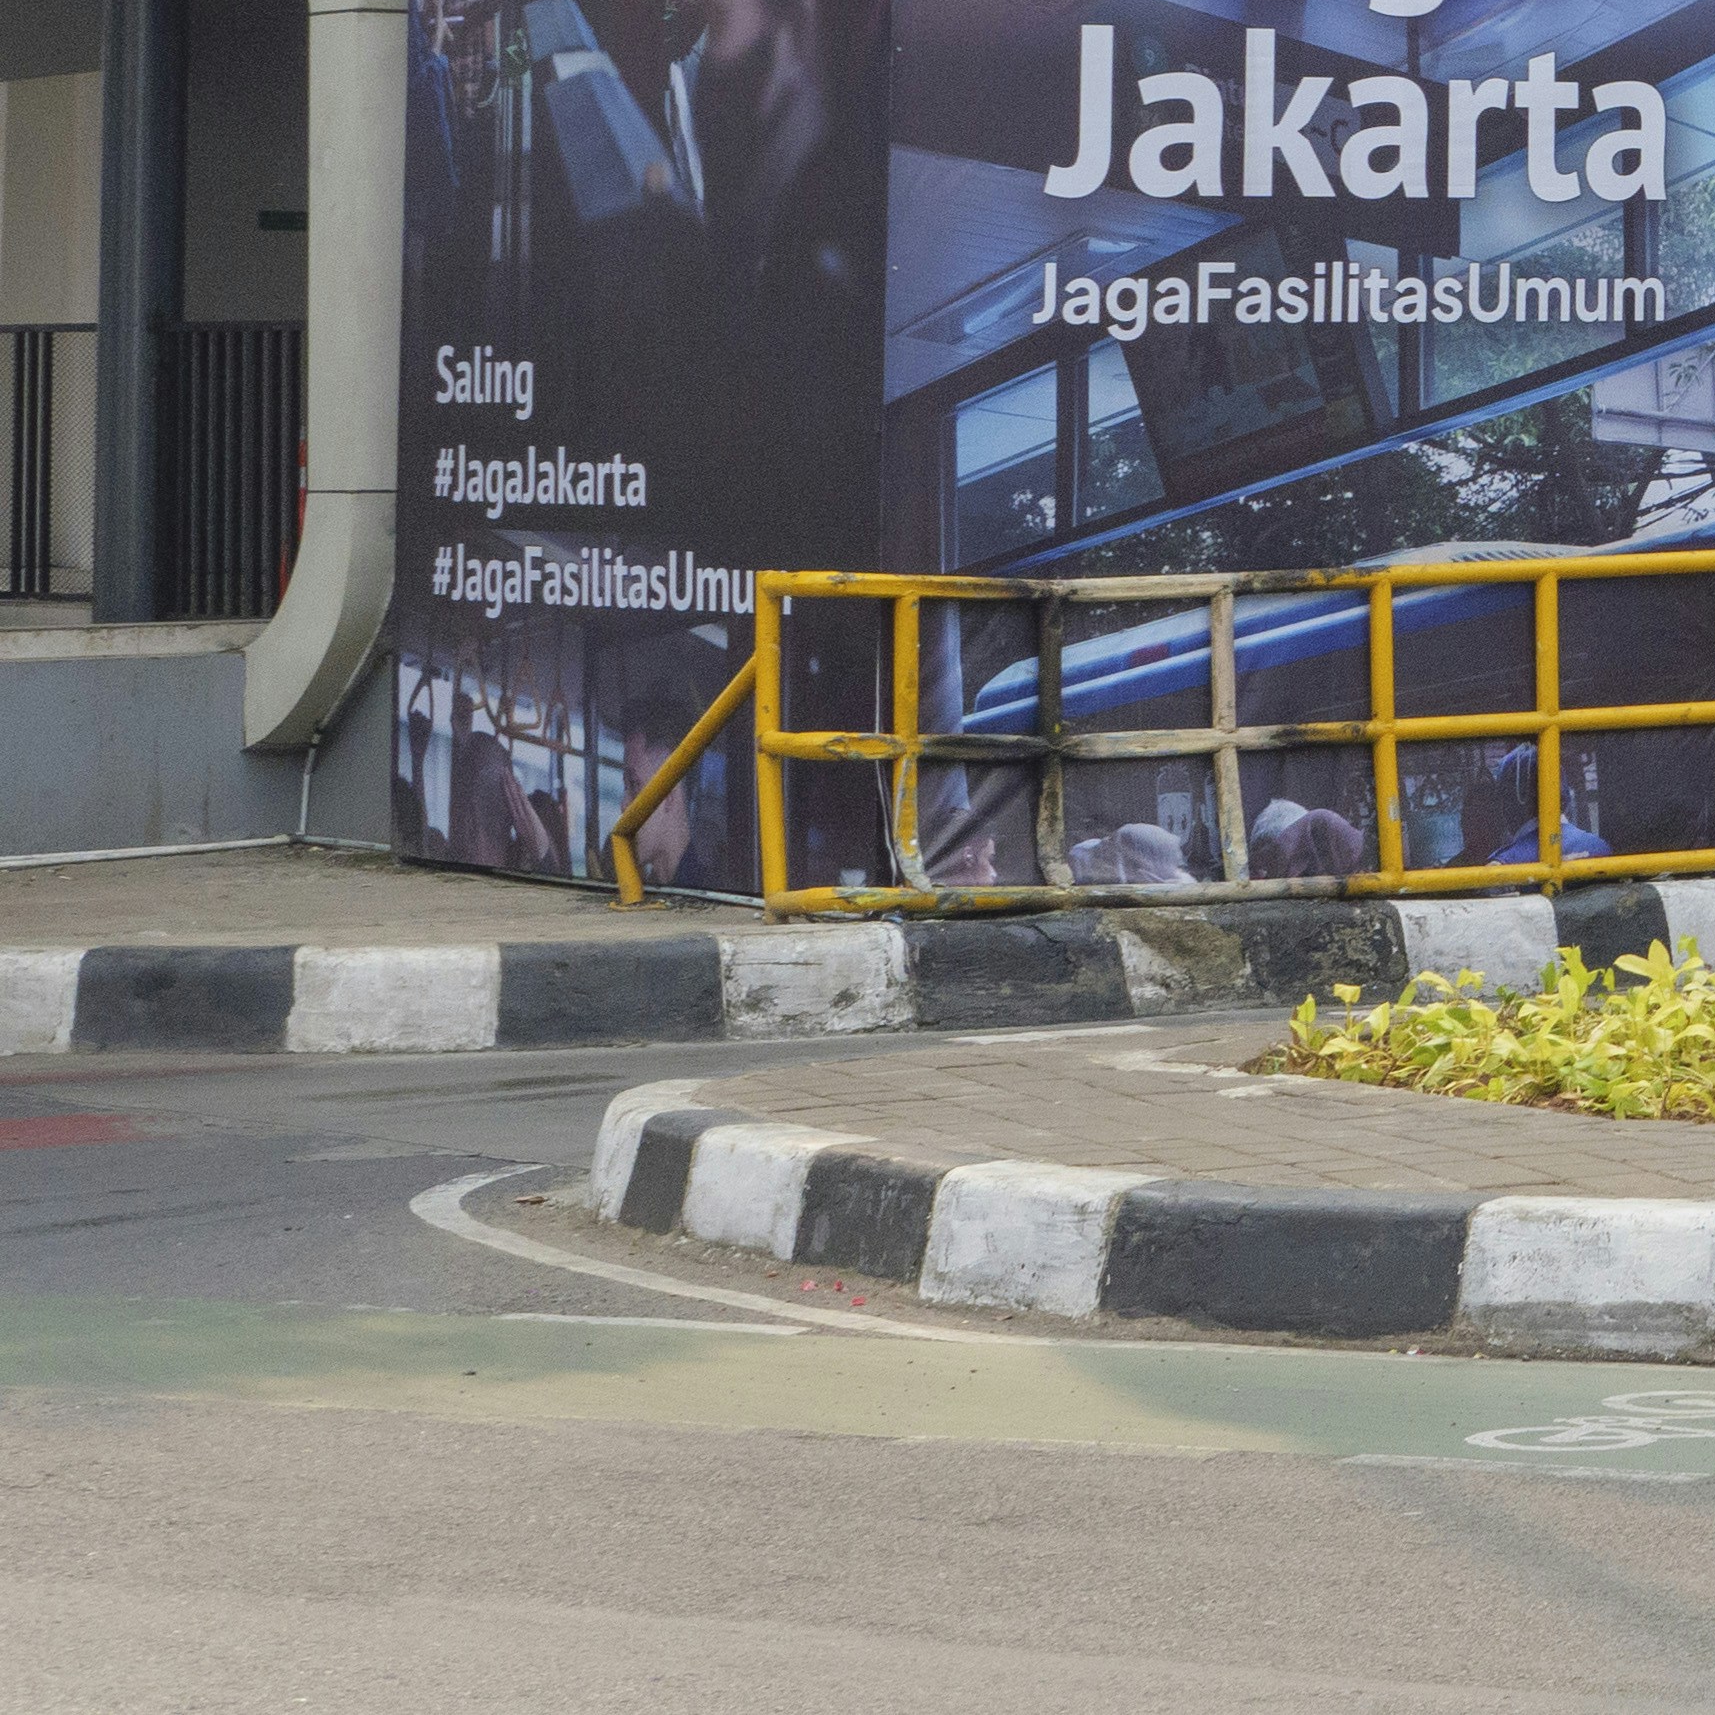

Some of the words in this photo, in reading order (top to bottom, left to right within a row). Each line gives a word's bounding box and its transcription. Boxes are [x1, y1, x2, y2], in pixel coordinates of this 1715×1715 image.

[1044, 24, 1668, 203] Jakarta
[1032, 261, 1666, 342] JagaFasilitasUmum
[436, 345, 535, 421] Saling
[434, 445, 647, 520] #JagaJakarta
